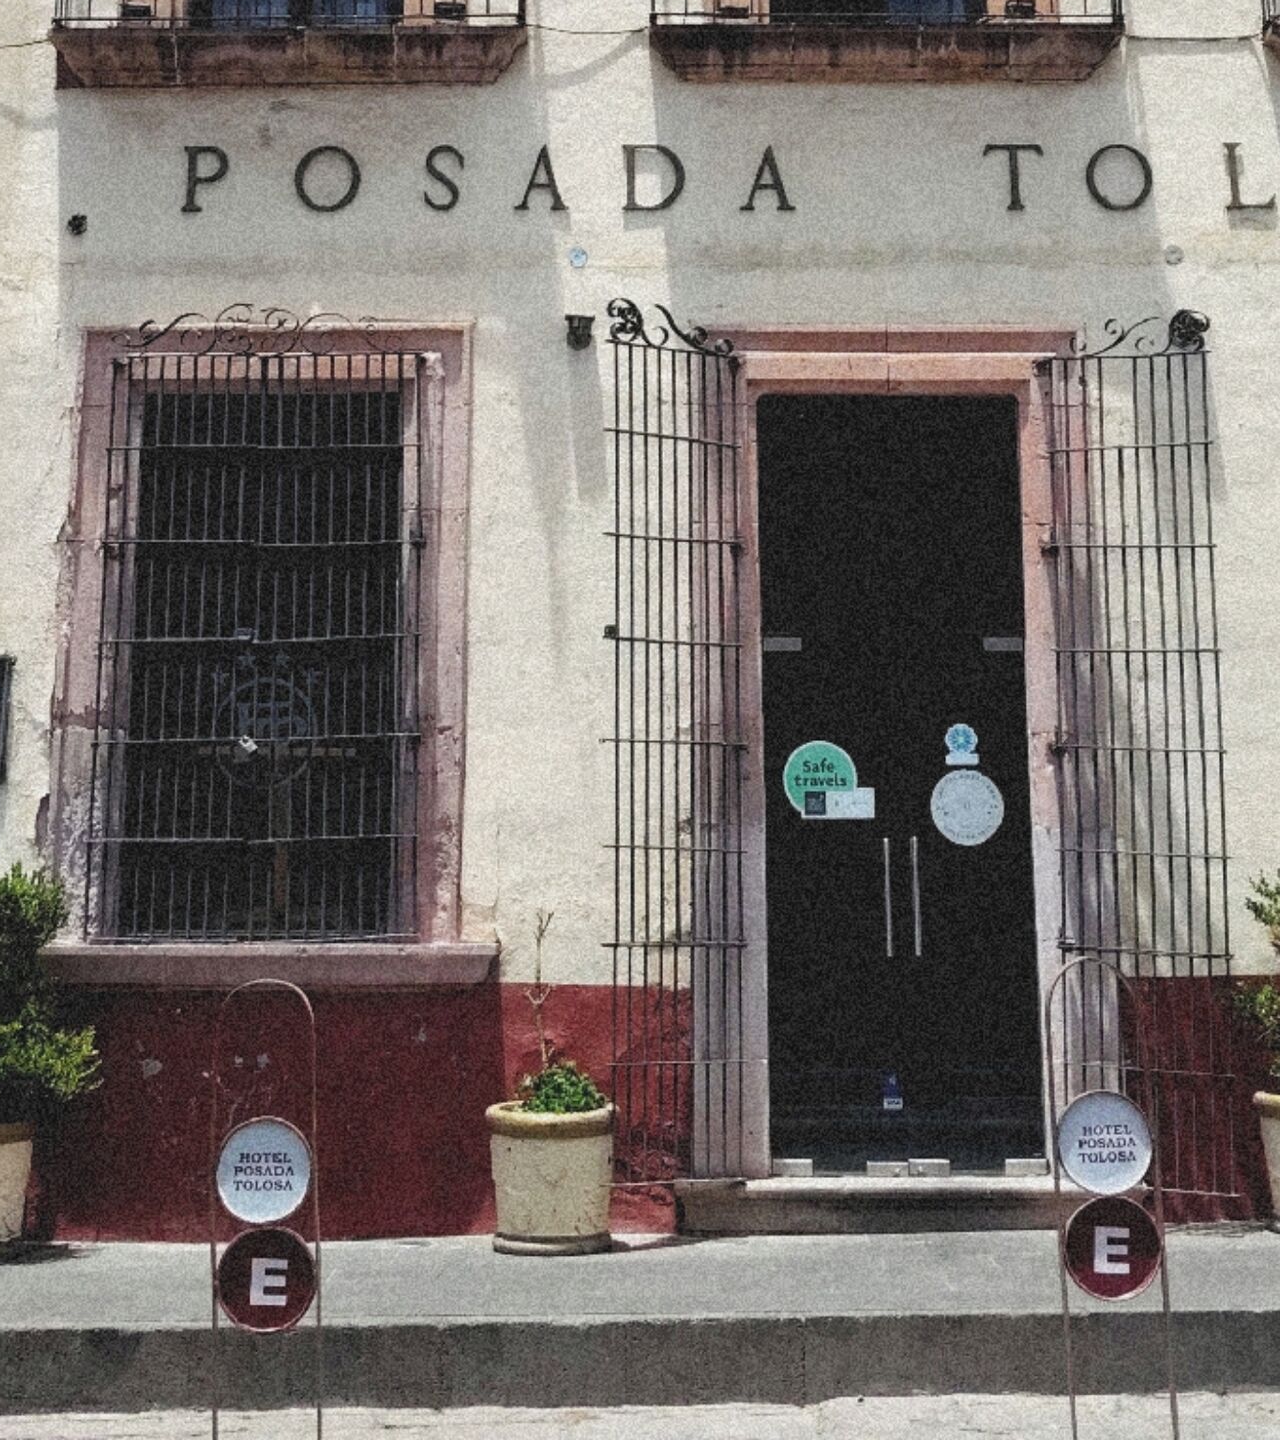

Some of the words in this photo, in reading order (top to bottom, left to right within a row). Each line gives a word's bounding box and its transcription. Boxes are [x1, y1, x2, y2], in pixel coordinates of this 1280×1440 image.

[181, 143, 796, 213] POSADA
[802, 757, 835, 773] Safe
[794, 772, 847, 787] travels
[1082, 1124, 1132, 1136] HOTEL
[1078, 1137, 1137, 1149] POSADA
[238, 1152, 292, 1163] HOTEL
[1078, 1151, 1137, 1164] TOLOSA
[233, 1166, 295, 1177] POSADA
[233, 1180, 293, 1191] TOLOSA
[1093, 1225, 1130, 1274] E
[249, 1257, 288, 1306] E
